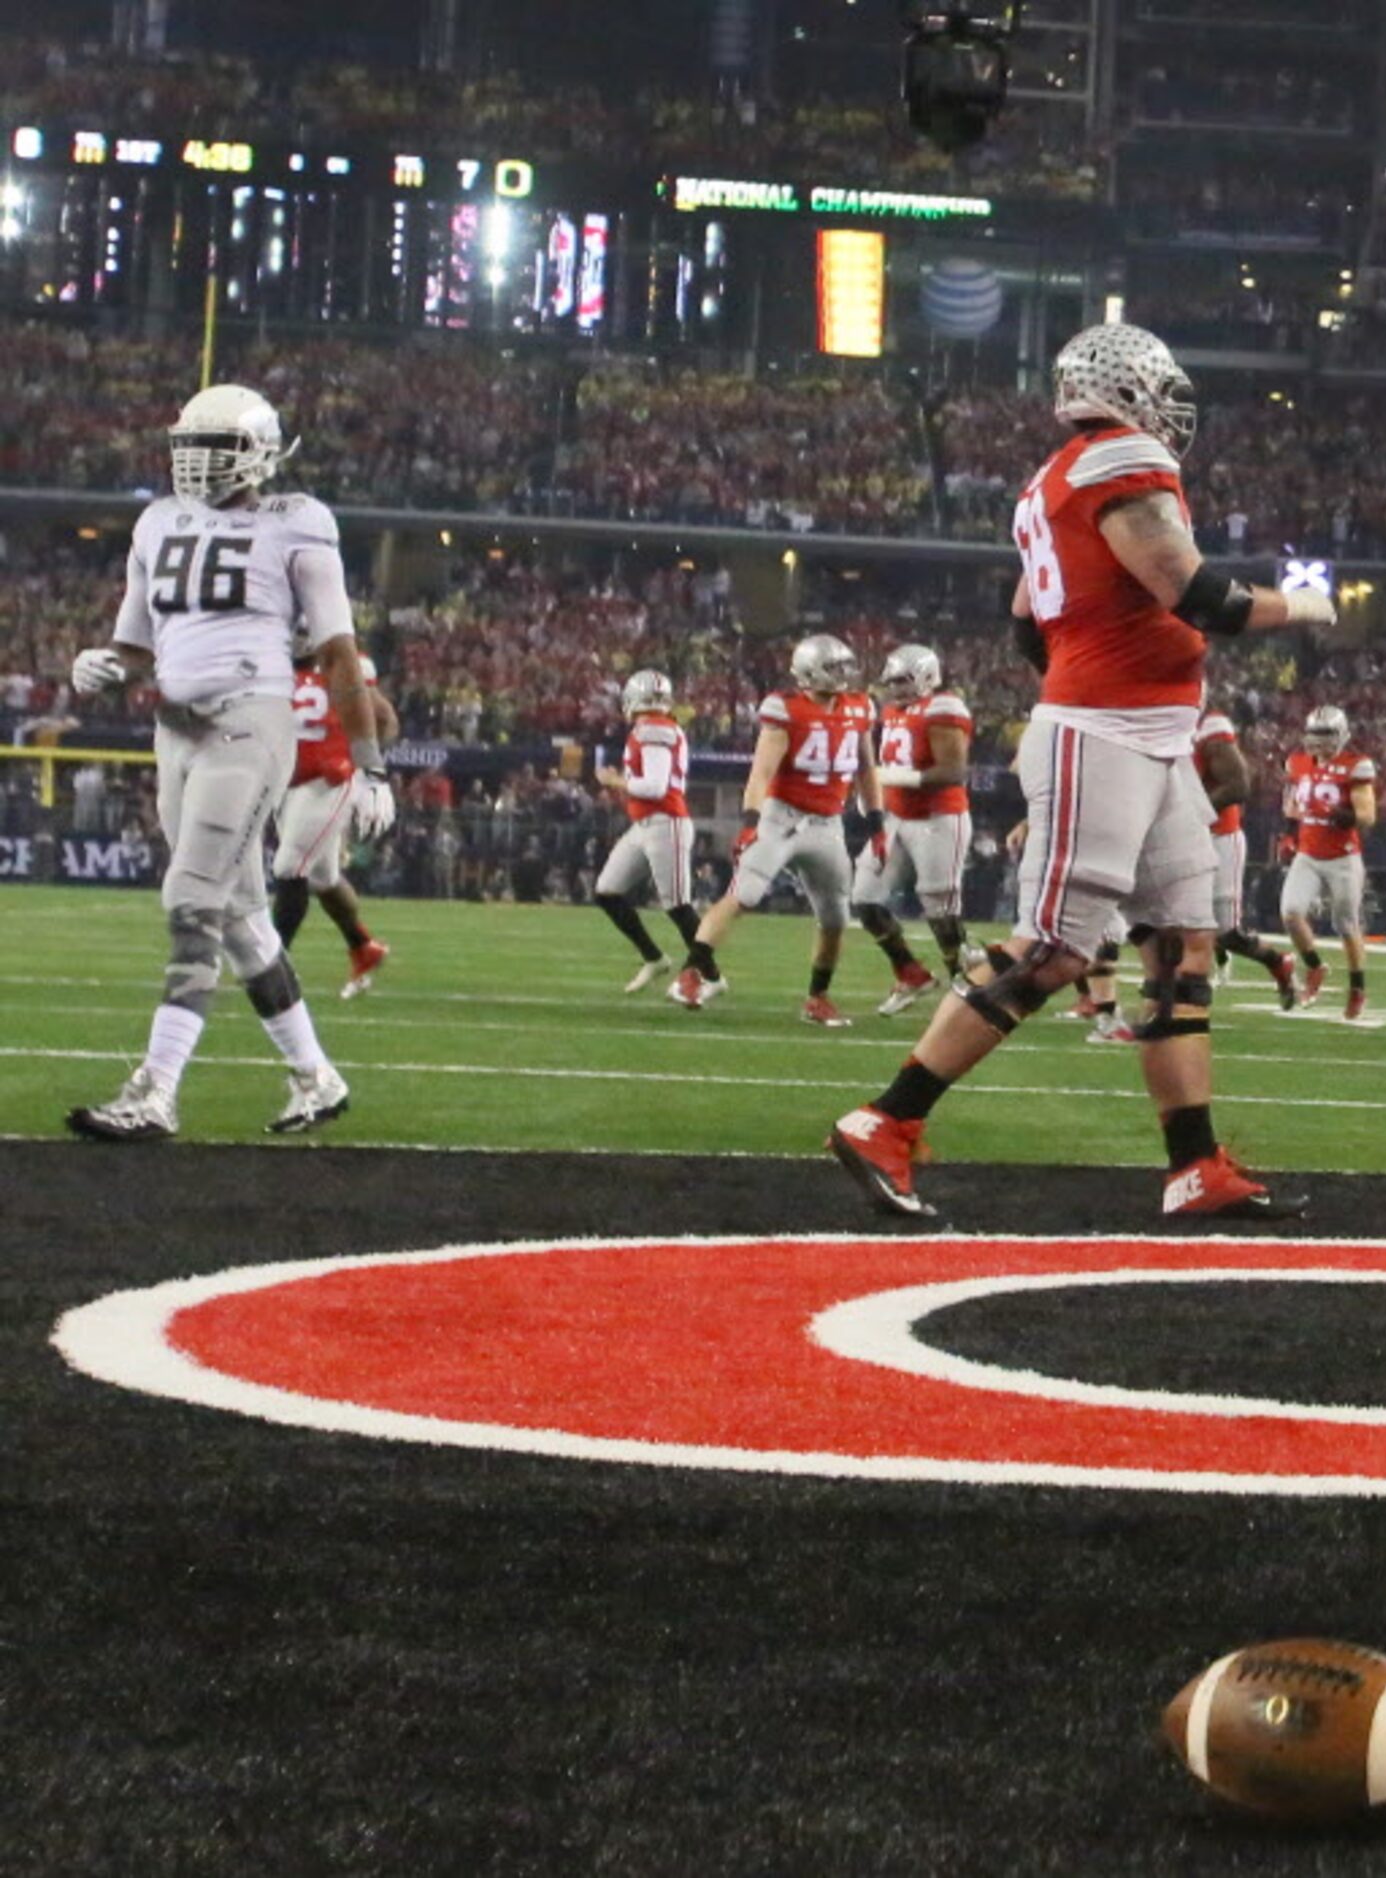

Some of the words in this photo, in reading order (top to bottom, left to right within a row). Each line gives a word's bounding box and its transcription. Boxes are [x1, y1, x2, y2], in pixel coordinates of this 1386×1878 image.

[675, 177, 799, 212] NATIONAL
[152, 535, 253, 614] 96
[795, 730, 859, 784] 44
